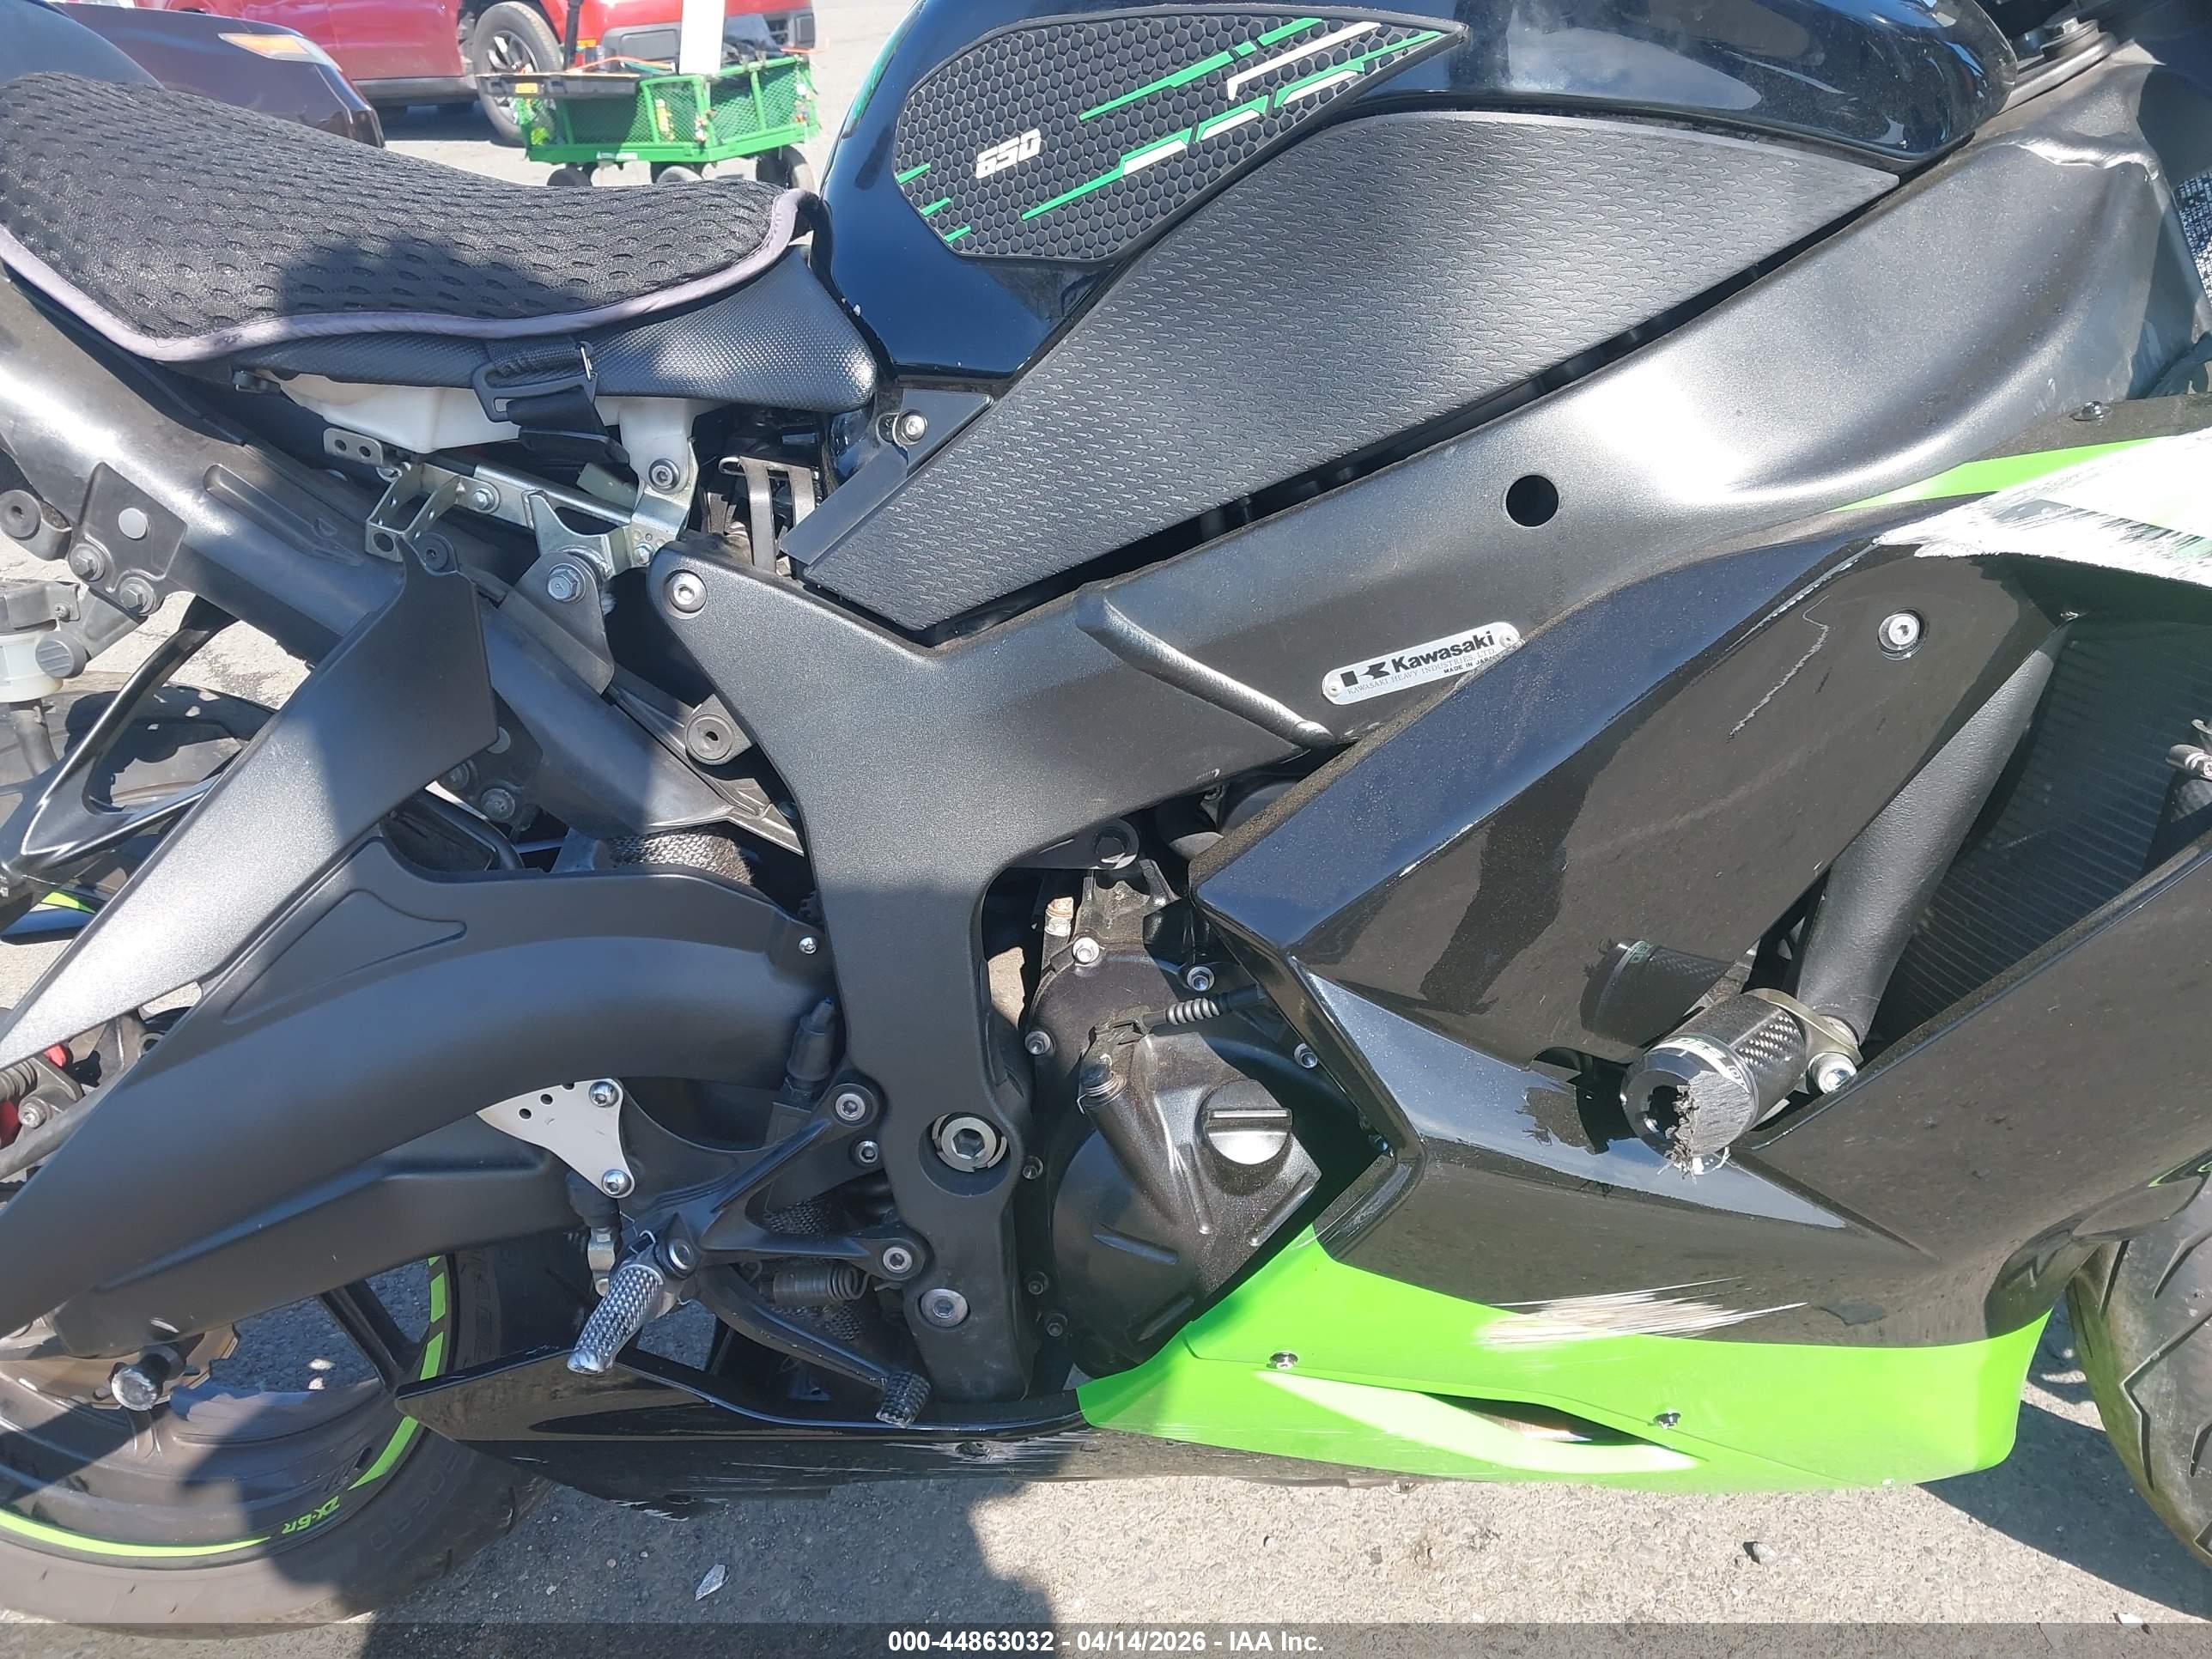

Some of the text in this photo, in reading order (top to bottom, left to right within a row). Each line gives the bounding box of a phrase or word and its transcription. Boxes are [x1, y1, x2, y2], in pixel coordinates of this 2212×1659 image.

[975, 129, 1042, 179] 650
[1391, 630, 1495, 673] Kawasaki
[1443, 665, 1464, 674] MADE
[1347, 678, 1389, 695] KAWASAKI
[1392, 669, 1419, 684] HEAVY
[281, 1495, 340, 1534] ZX-6R
